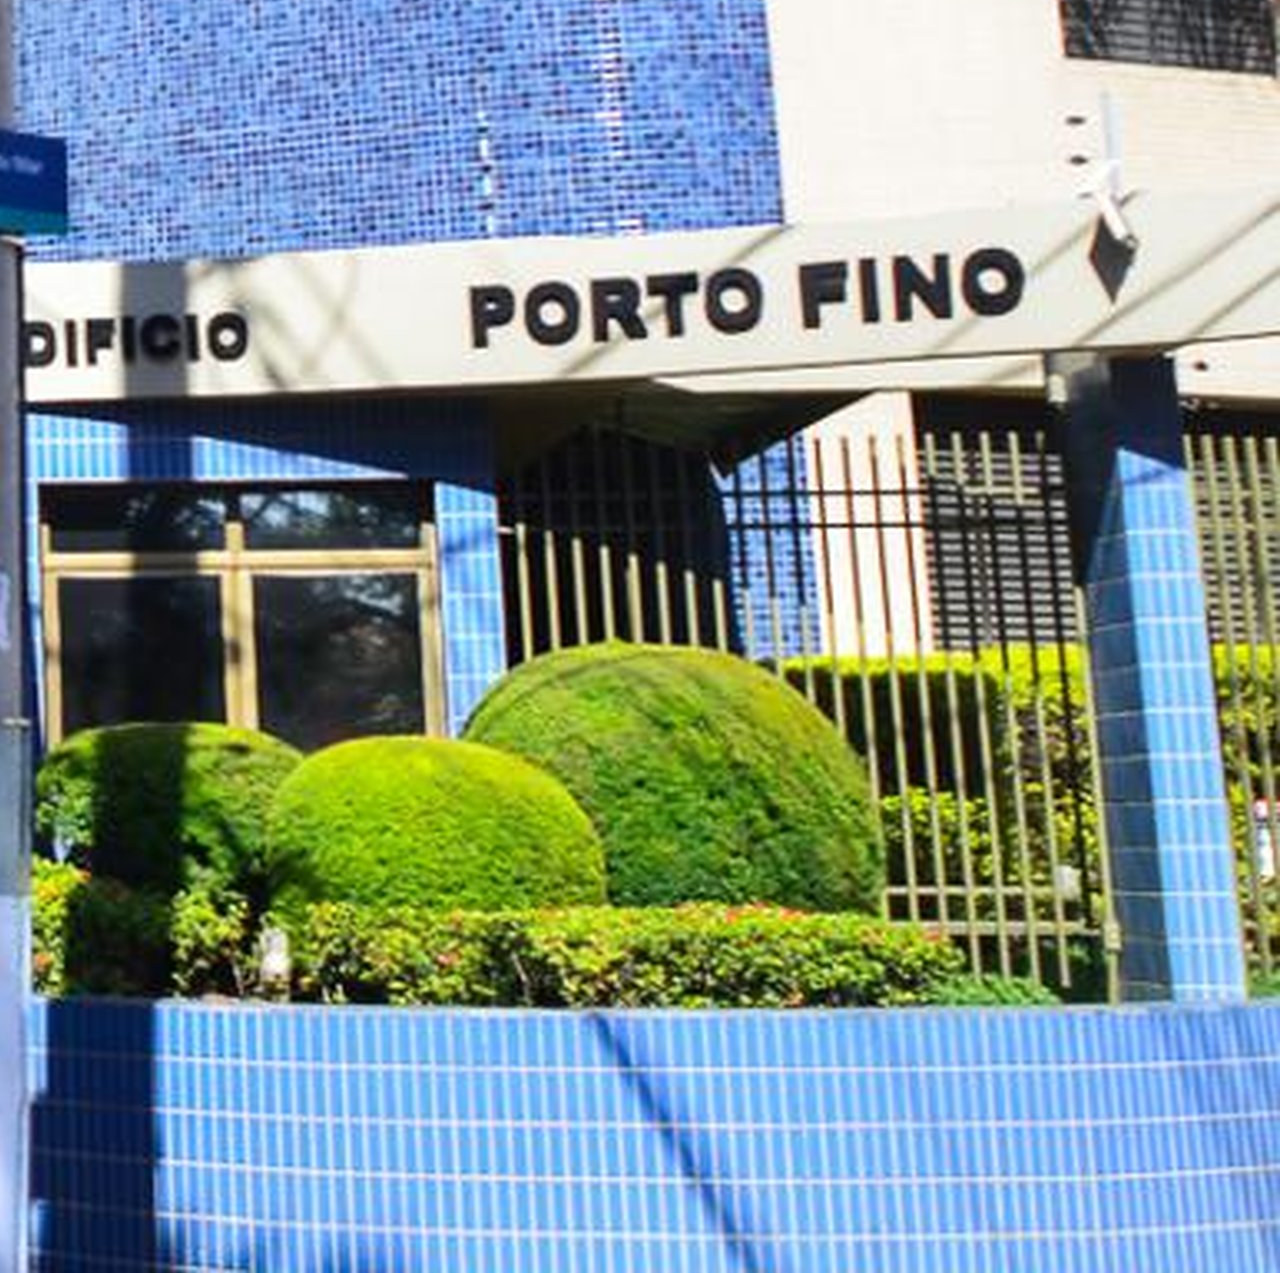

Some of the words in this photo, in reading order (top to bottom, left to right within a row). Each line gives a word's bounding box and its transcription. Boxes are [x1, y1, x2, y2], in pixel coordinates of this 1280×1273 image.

[22, 311, 250, 371] DIFICIO
[468, 266, 764, 349] PORTO
[797, 247, 1026, 329] FINO
